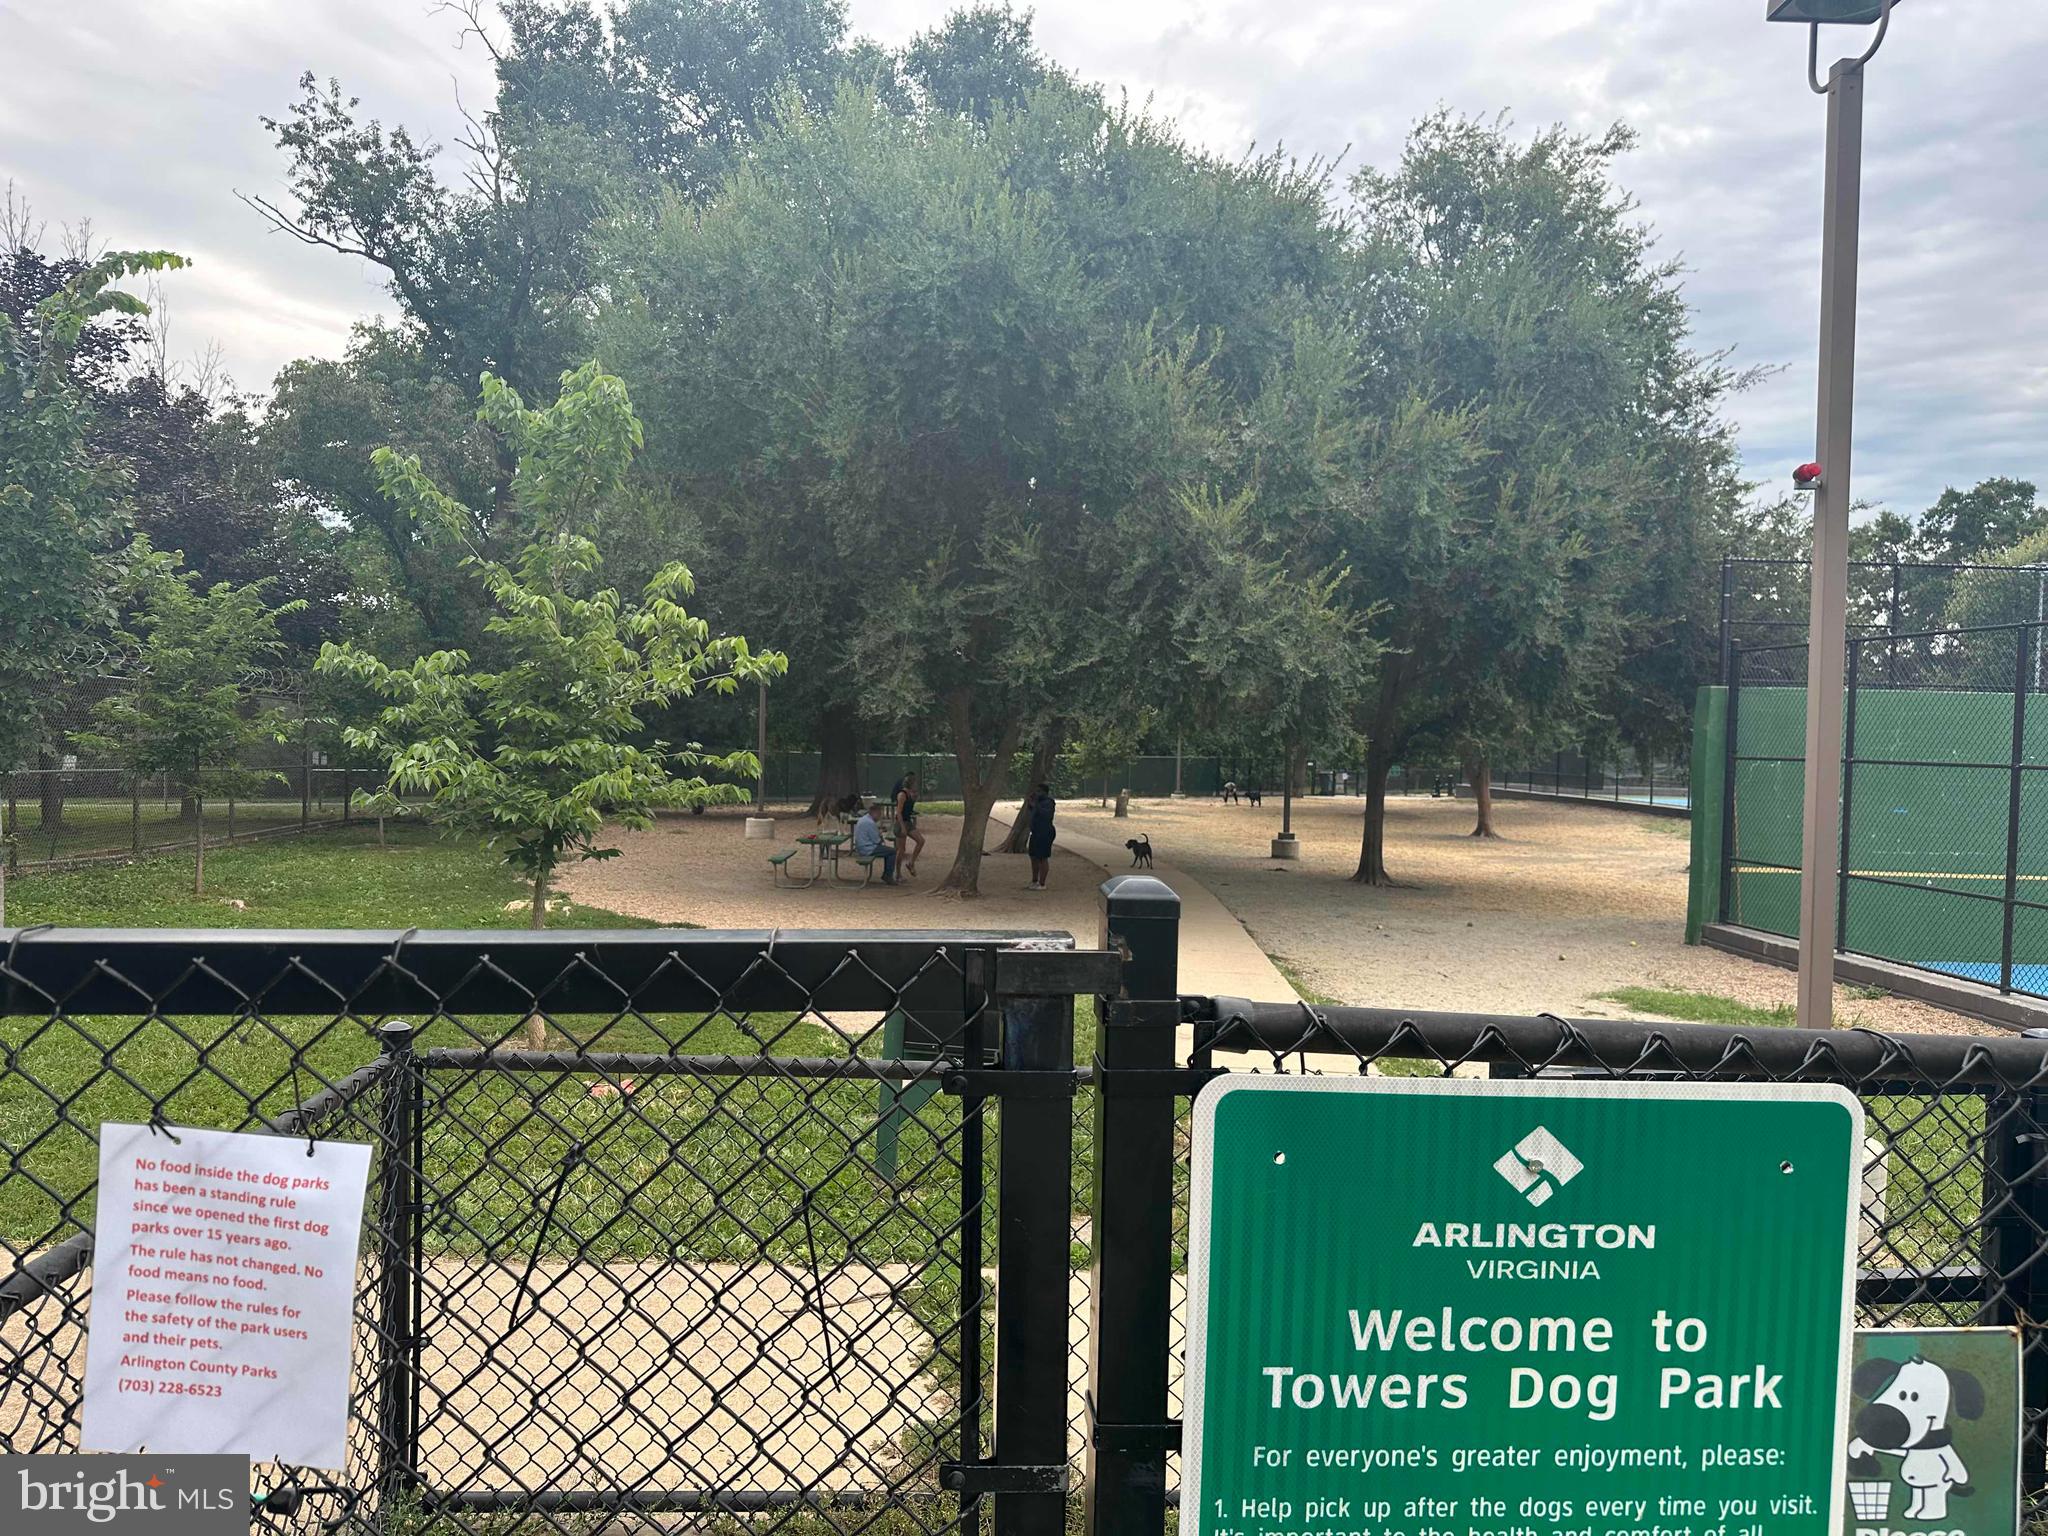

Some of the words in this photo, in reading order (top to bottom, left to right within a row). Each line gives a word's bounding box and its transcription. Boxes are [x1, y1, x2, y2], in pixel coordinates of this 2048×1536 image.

[136, 1158, 156, 1170] No
[160, 1160, 191, 1174] food
[195, 1164, 233, 1180] inside
[237, 1170, 259, 1183] the
[263, 1172, 289, 1189] dog
[292, 1177, 329, 1190] parks
[135, 1179, 158, 1191] has
[163, 1181, 195, 1195] been
[199, 1188, 206, 1197] a
[211, 1189, 266, 1208] standing
[270, 1196, 296, 1209] rule
[133, 1200, 168, 1213] since
[172, 1206, 192, 1216] we
[196, 1209, 244, 1223] opened
[248, 1214, 269, 1227] the
[274, 1216, 300, 1230] first
[304, 1220, 329, 1236] dog
[132, 1222, 169, 1234] parks
[173, 1227, 203, 1237] over
[208, 1229, 222, 1240] 15
[226, 1234, 260, 1246] years
[264, 1239, 291, 1251] ago.
[1413, 1223, 1655, 1248] ARLINGTON
[130, 1244, 155, 1257] The
[160, 1248, 186, 1260] rule
[190, 1250, 212, 1263] has
[216, 1256, 238, 1266] not
[242, 1258, 300, 1275] changed.
[305, 1266, 323, 1278] No
[1467, 1261, 1600, 1279] VIRGINIA
[129, 1265, 160, 1278] food
[165, 1271, 208, 1283] means
[213, 1276, 229, 1285] no
[233, 1275, 266, 1290] food.
[127, 1290, 171, 1304] Please
[175, 1292, 217, 1308] follow
[221, 1299, 242, 1311] the
[247, 1303, 278, 1315] rules
[282, 1305, 300, 1318] for
[125, 1310, 148, 1323] the
[152, 1313, 194, 1328] safety
[197, 1316, 211, 1328] of
[215, 1318, 237, 1330] the
[241, 1323, 269, 1334] park
[274, 1328, 307, 1340] users
[1349, 1307, 1612, 1352] Welcome
[1652, 1311, 1706, 1352] to
[123, 1332, 149, 1343] and
[153, 1333, 186, 1346] their
[190, 1338, 222, 1349] pets.
[121, 1355, 185, 1371] Arlington
[190, 1360, 238, 1377] County
[242, 1365, 277, 1379] Parks
[119, 1379, 154, 1394] (703)
[159, 1382, 221, 1397] 228-6523
[1263, 1367, 1467, 1408] Towers
[1510, 1368, 1617, 1420] Dog
[1660, 1365, 1782, 1408] Park
[1254, 1447, 1291, 1466] For
[1307, 1446, 1437, 1472] everyone's
[1453, 1446, 1540, 1472] greater
[1555, 1445, 1686, 1472] enjoyment,
[1702, 1445, 1784, 1471] please:
[1216, 1499, 1227, 1517] 1.
[1242, 1498, 1291, 1522] Help
[1306, 1498, 1349, 1522] pick
[1365, 1502, 1390, 1522] up
[1405, 1497, 1457, 1517] after
[1471, 1497, 1506, 1516] the
[1520, 1497, 1572, 1521] dogs
[1586, 1501, 1646, 1521] every
[1659, 1496, 1705, 1515] time
[1719, 1500, 1756, 1520] you
[1771, 1495, 1816, 1514] visit.
